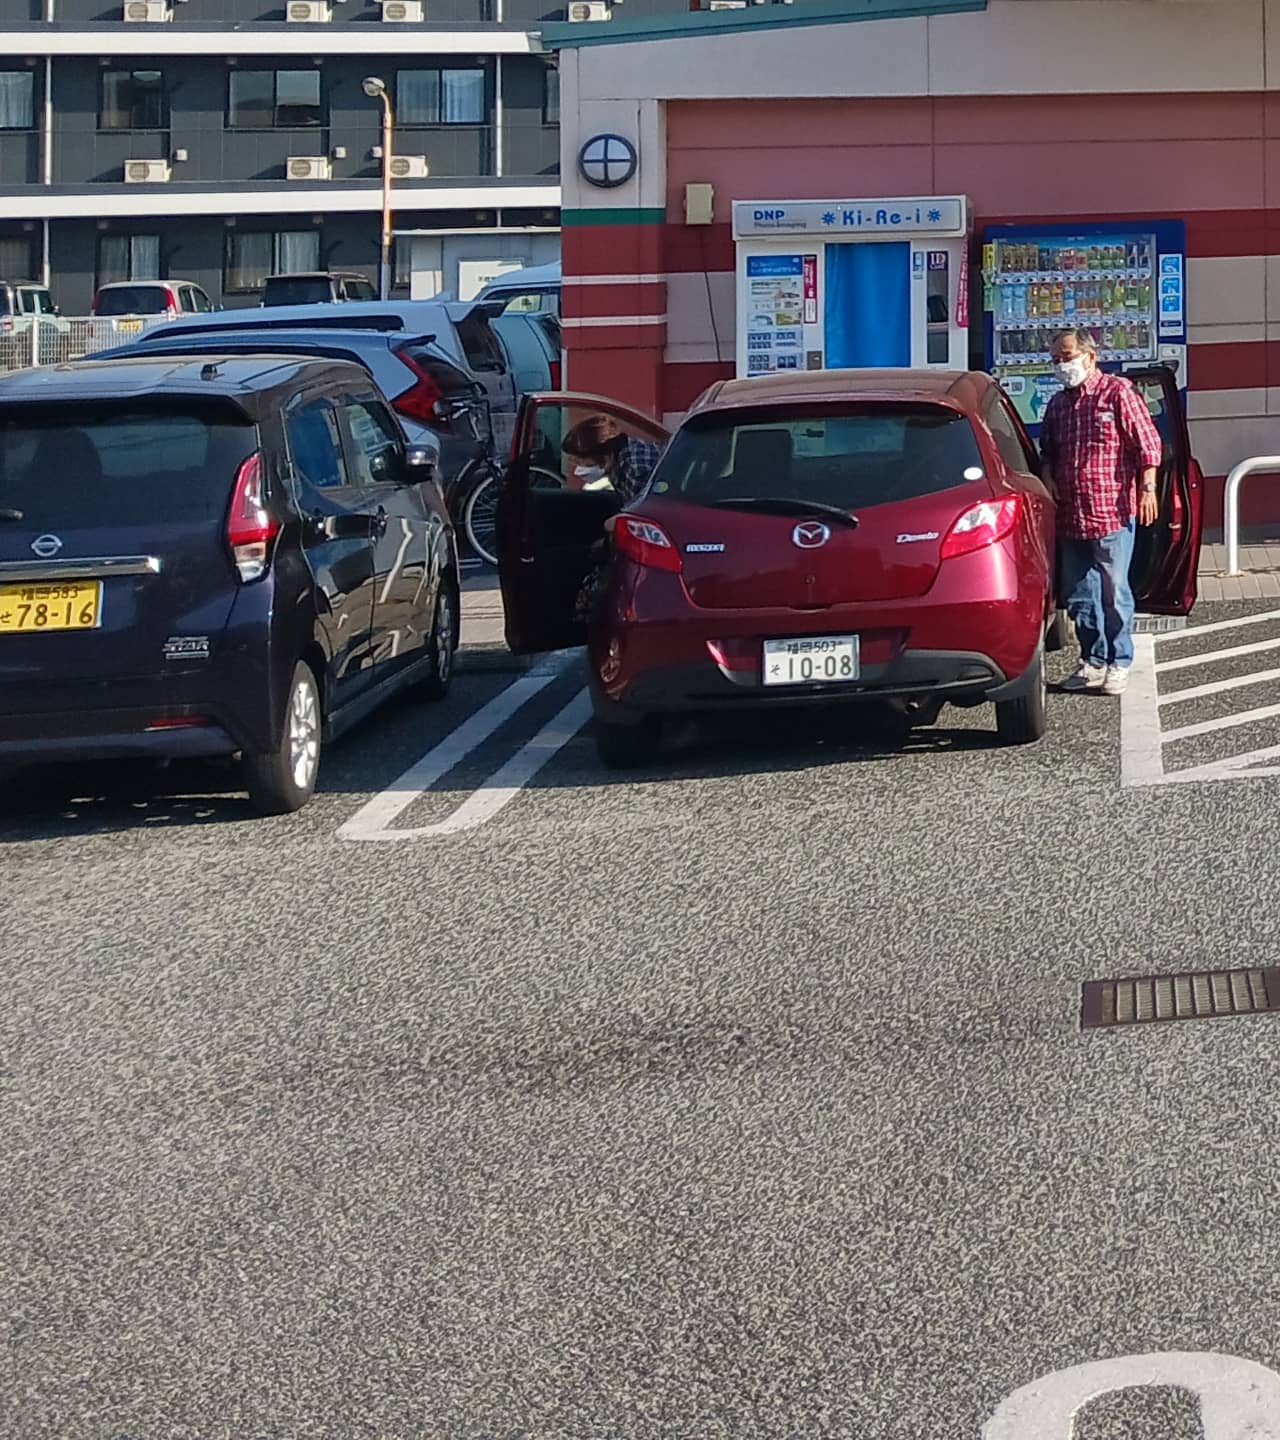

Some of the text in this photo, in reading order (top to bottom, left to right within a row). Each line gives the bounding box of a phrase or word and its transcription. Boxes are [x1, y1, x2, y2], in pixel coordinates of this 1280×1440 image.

[753, 210, 785, 221] DNP
[16, 601, 94, 628] 78-16
[788, 654, 852, 680] 10-08
